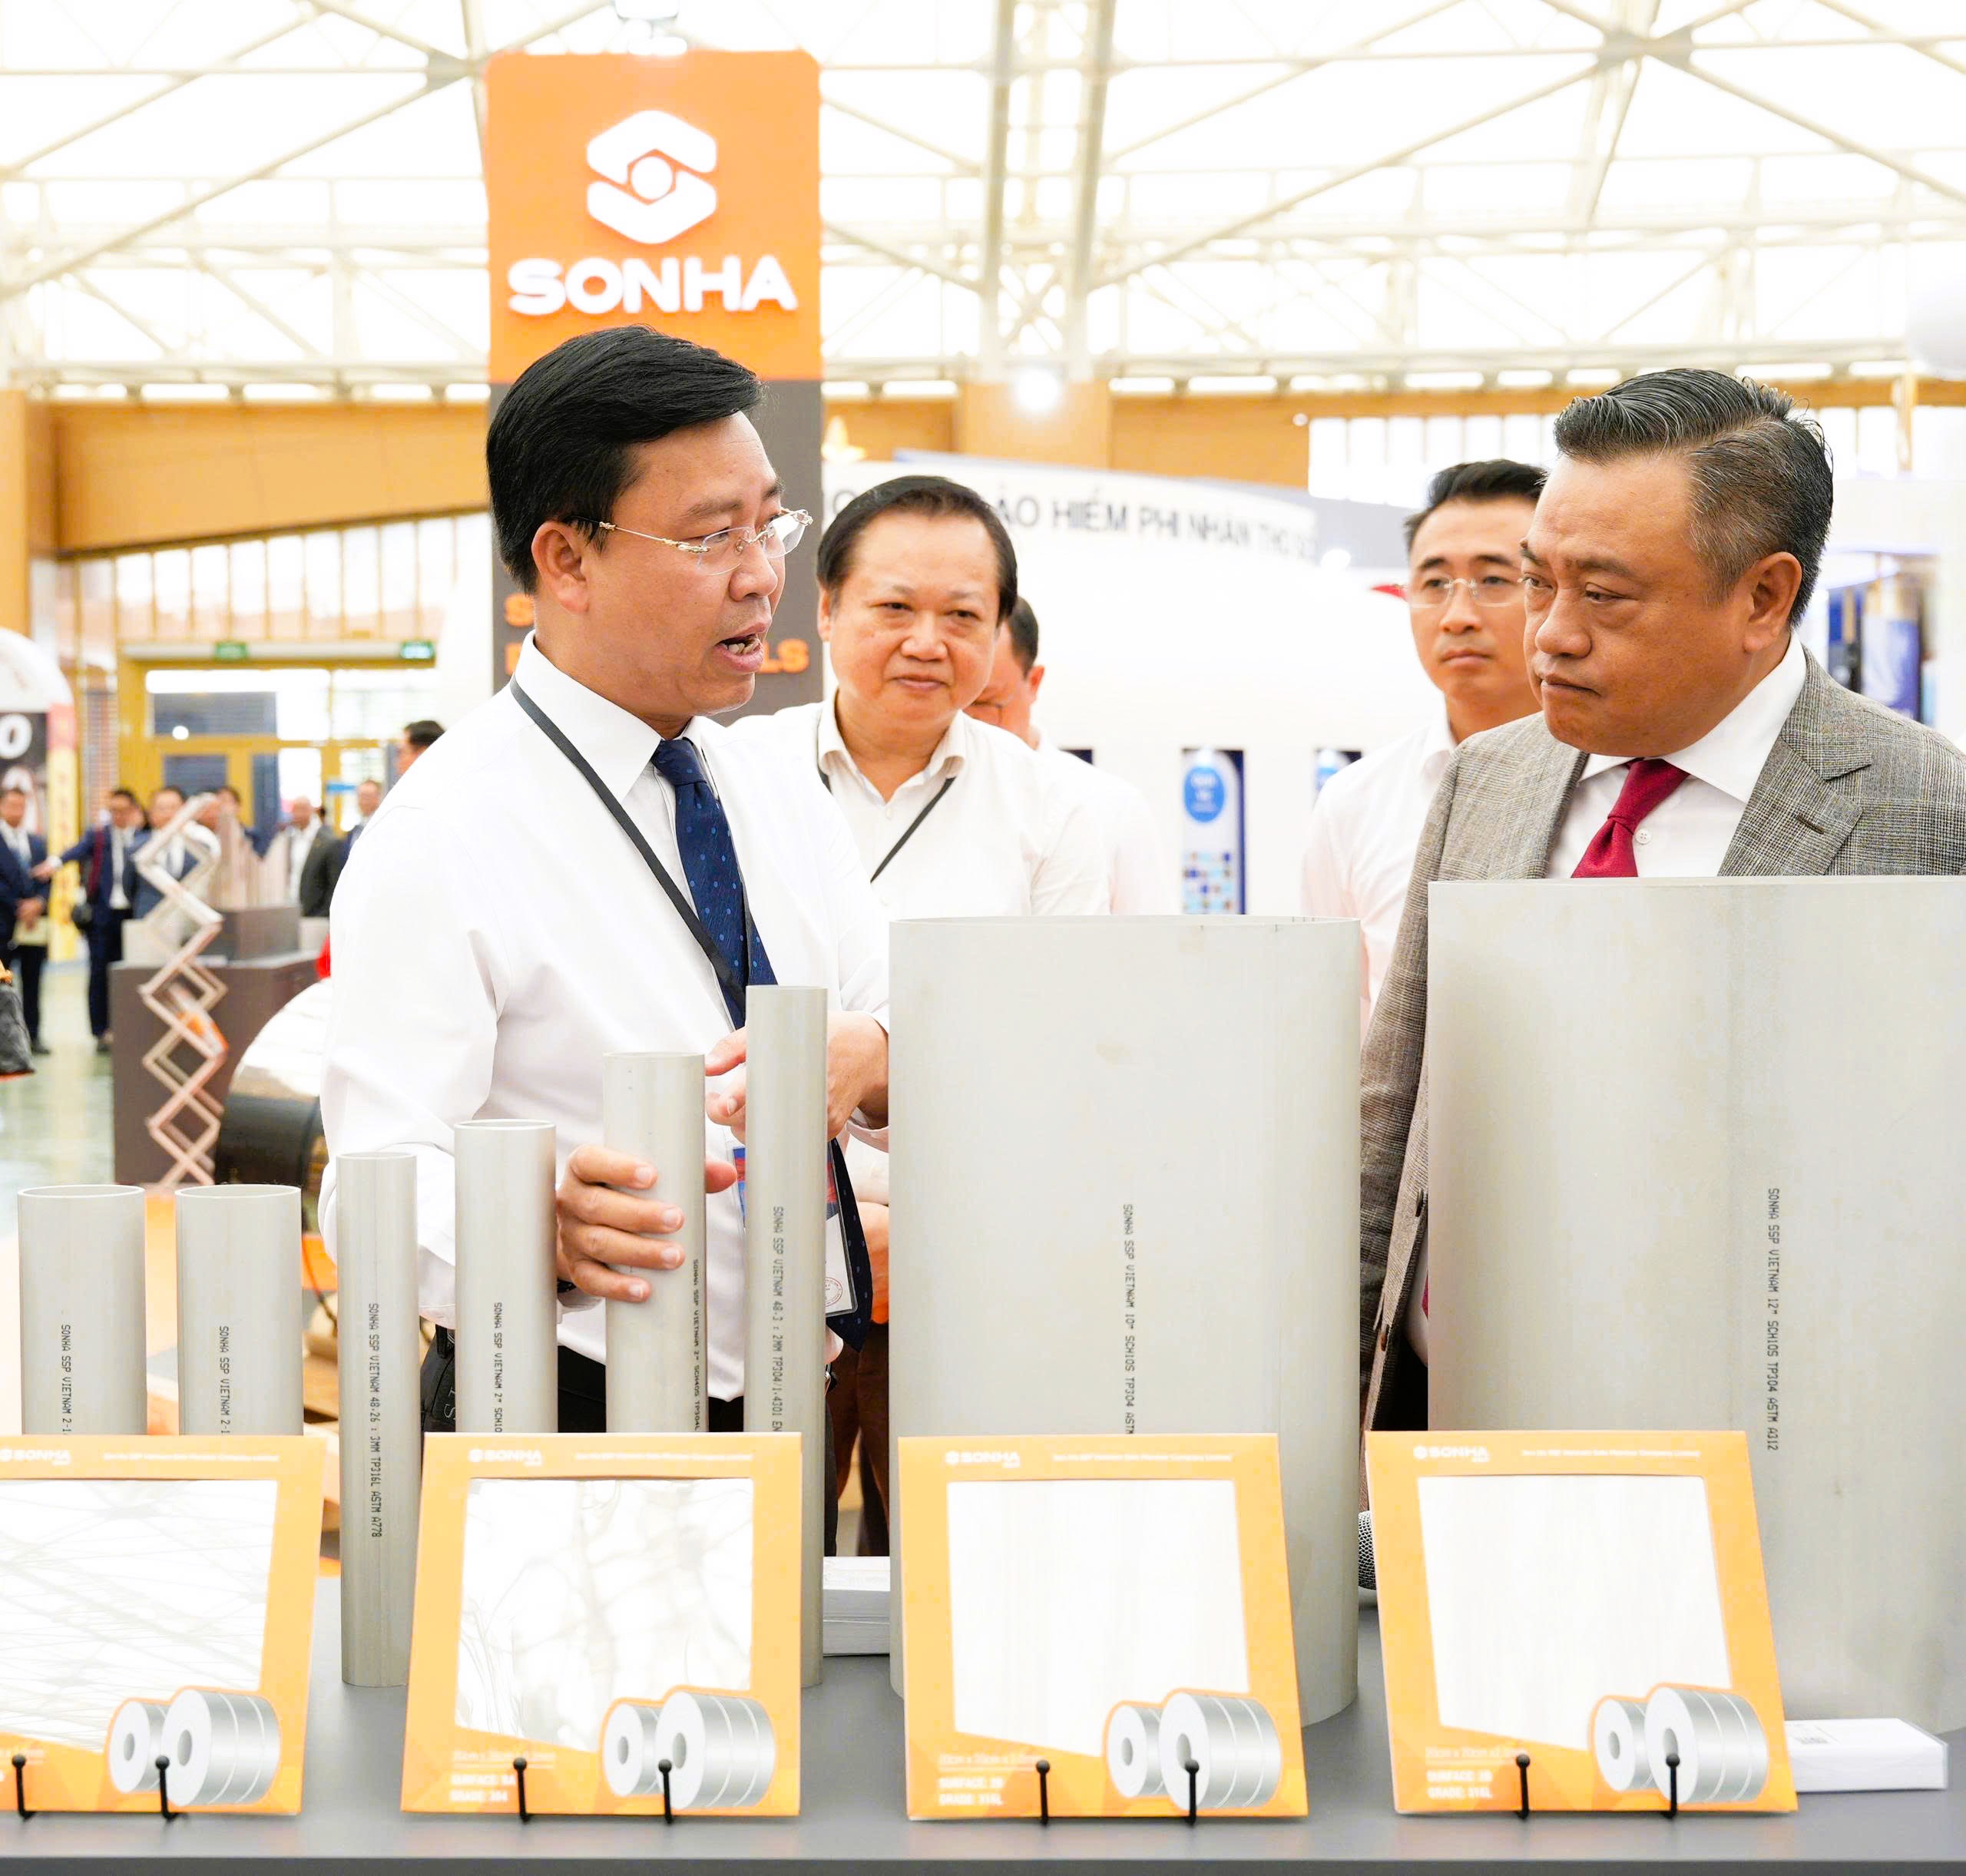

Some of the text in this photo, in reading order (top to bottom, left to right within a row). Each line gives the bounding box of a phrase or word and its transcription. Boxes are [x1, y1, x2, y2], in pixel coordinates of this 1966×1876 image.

[508, 254, 799, 316] SONHA
[1137, 506, 1178, 538] PHI
[1768, 1187, 1780, 1219] SONHA
[773, 1206, 784, 1233] SONHA
[1123, 1203, 1134, 1235] SONHA
[773, 1237, 784, 1255] SSP
[1768, 1224, 1779, 1245] SSP
[1124, 1239, 1134, 1260] SSP
[773, 1259, 784, 1297] VIETNAM
[1768, 1249, 1779, 1292] VIETNAM
[1124, 1264, 1135, 1308] VIETNAM
[368, 1302, 379, 1330] SONHA
[494, 1302, 503, 1329] SONHA
[61, 1324, 71, 1352] SONHA
[219, 1325, 230, 1353] SONHA
[369, 1333, 380, 1352] SSP
[494, 1332, 503, 1349] SSP
[1767, 1320, 1779, 1358] SCH10S
[61, 1355, 72, 1373] SSP
[220, 1357, 230, 1375] SSP
[369, 1355, 380, 1393] VIETNAM
[494, 1352, 503, 1389] VIETNAM
[1767, 1362, 1779, 1392] TP304
[61, 1377, 72, 1414] VIETNAM
[220, 1378, 231, 1416] VIETNAM
[1124, 1376, 1135, 1407] TP304
[369, 1396, 381, 1423] 48.26
[1767, 1397, 1779, 1423] ASTM
[370, 1435, 381, 1452] 3MM
[1767, 1427, 1779, 1451] A312
[370, 1456, 382, 1487] TP316L
[371, 1491, 382, 1513] ASTM
[371, 1517, 382, 1538] A778
